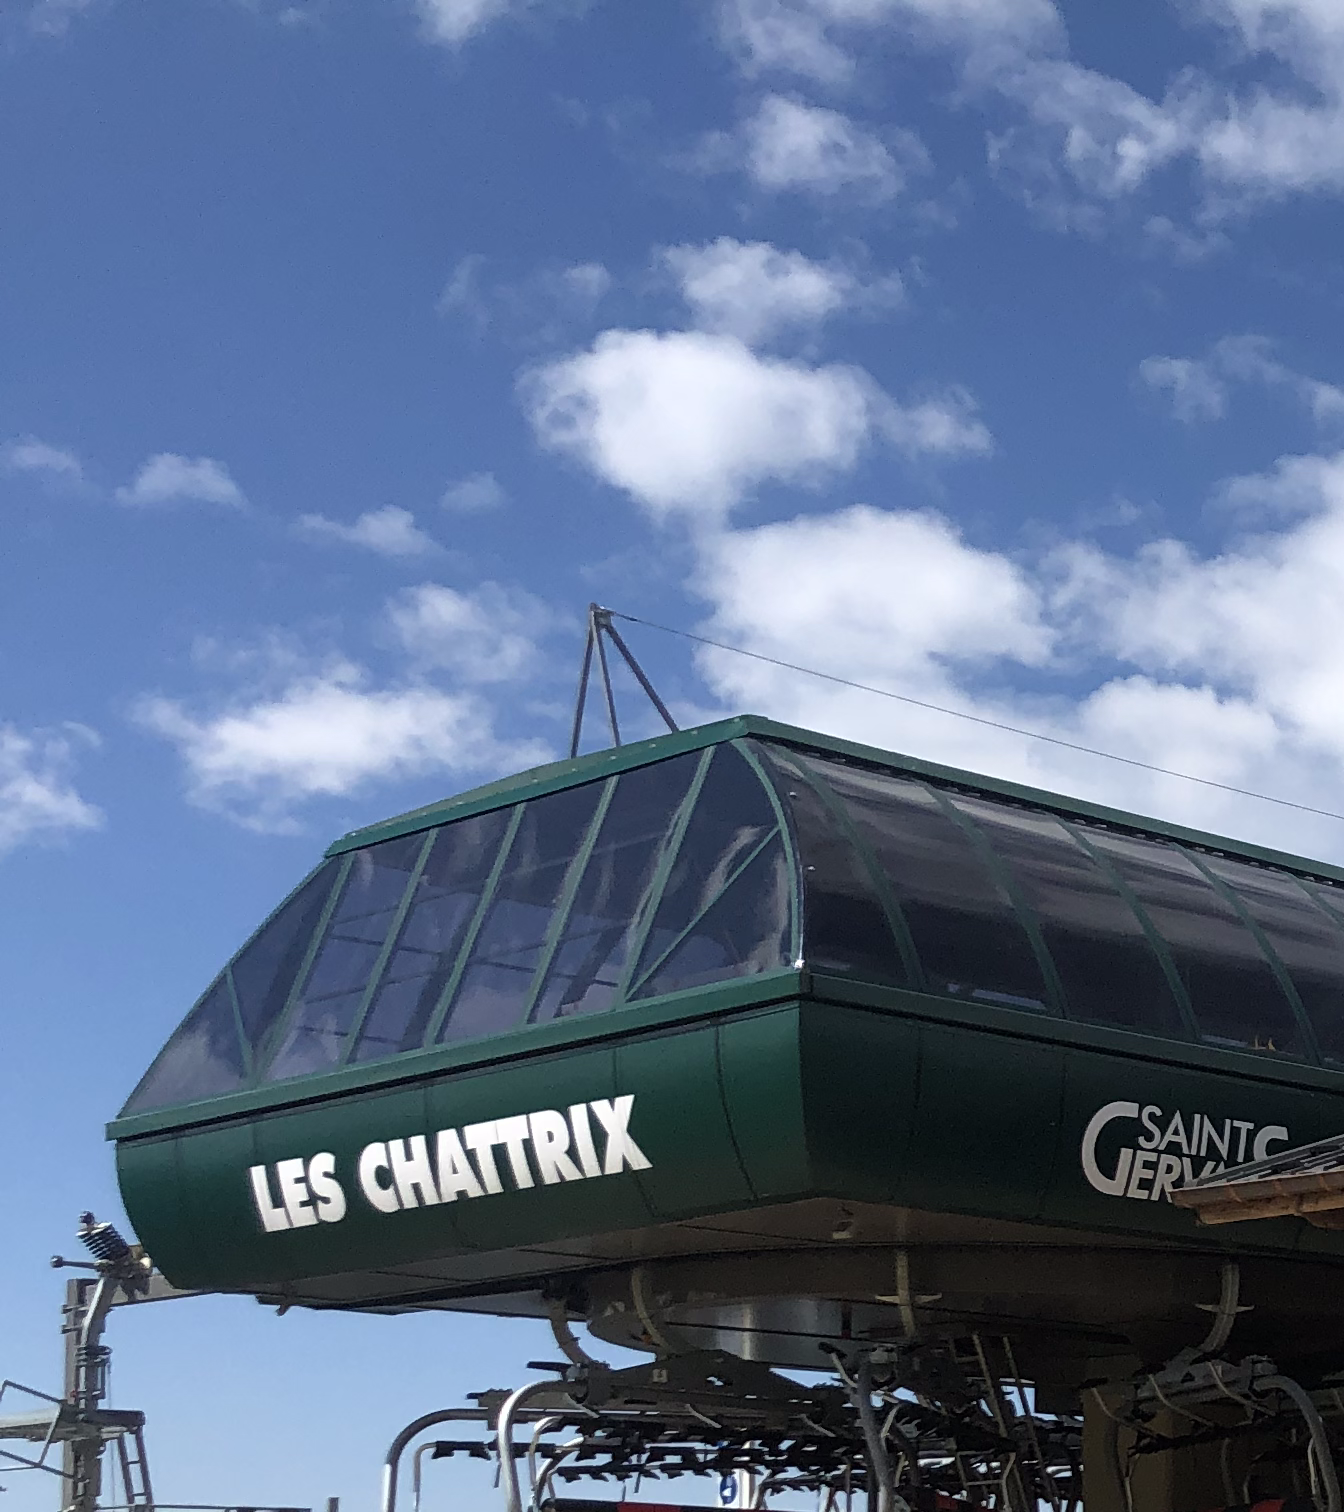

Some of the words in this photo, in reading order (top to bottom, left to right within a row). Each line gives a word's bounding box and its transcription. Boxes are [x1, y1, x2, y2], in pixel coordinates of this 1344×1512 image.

[249, 1152, 346, 1233] LES
[357, 1094, 653, 1214] CHATTRIX
[1137, 1104, 1254, 1163] SAINT
